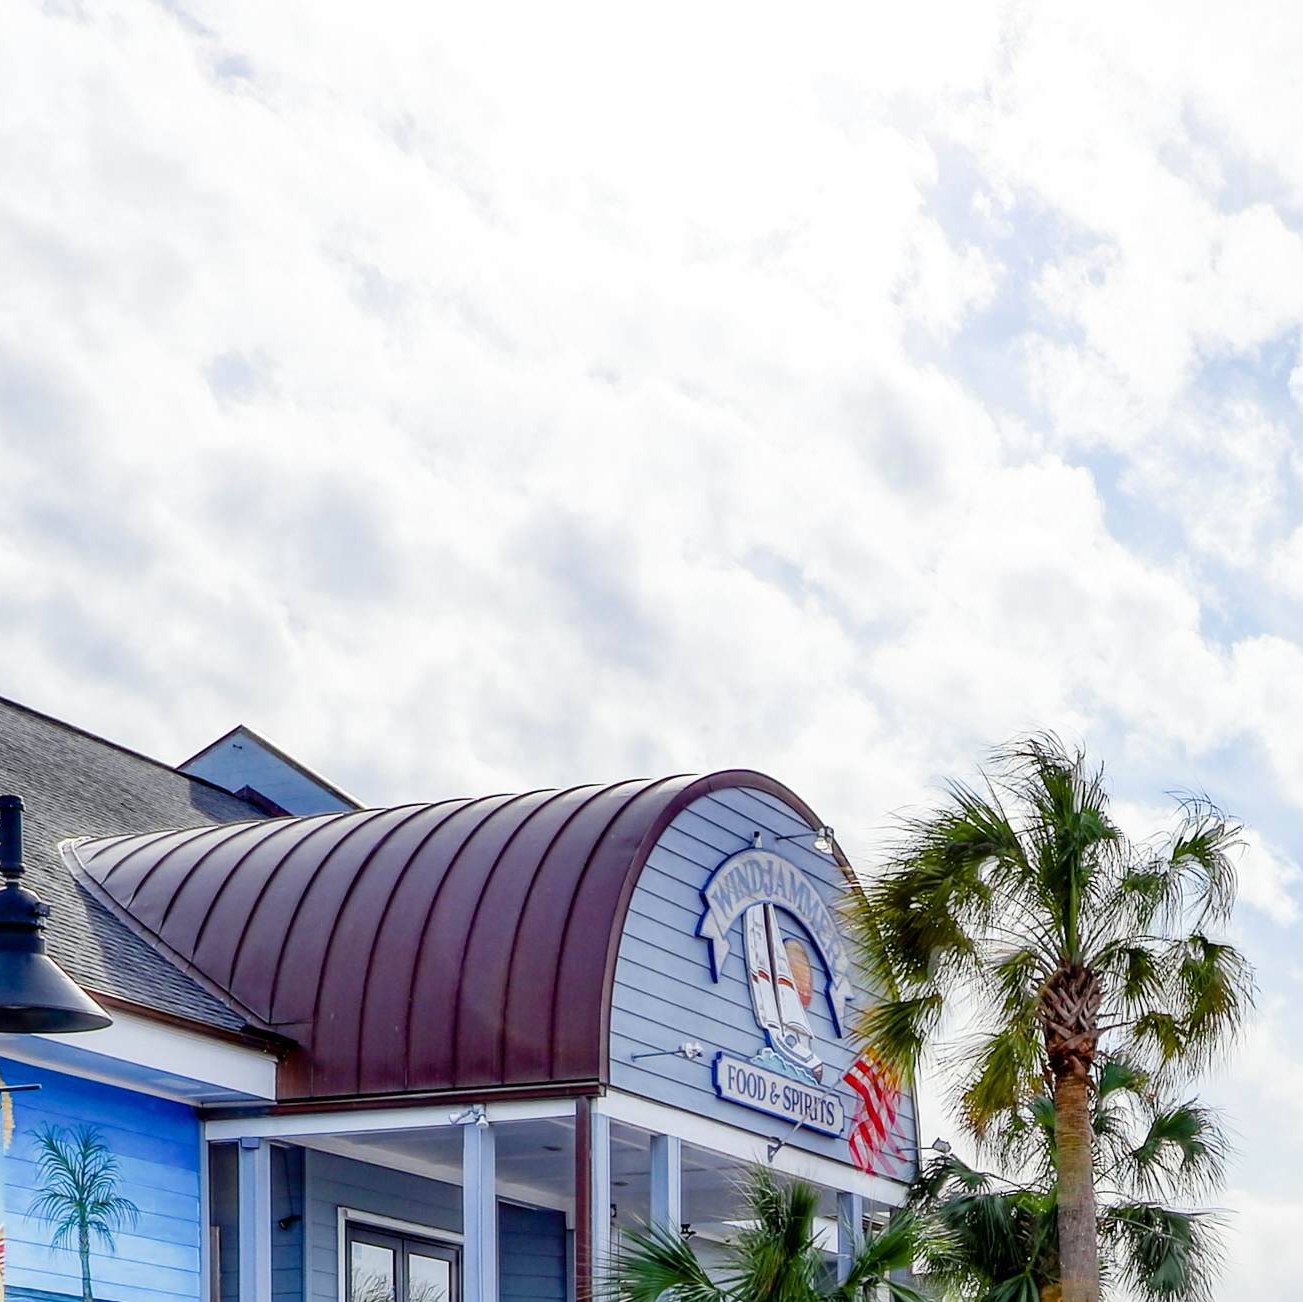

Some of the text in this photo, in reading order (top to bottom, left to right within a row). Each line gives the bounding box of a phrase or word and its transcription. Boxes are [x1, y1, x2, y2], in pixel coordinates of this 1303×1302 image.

[727, 1065, 835, 1126] FOOD & SPIRITS
